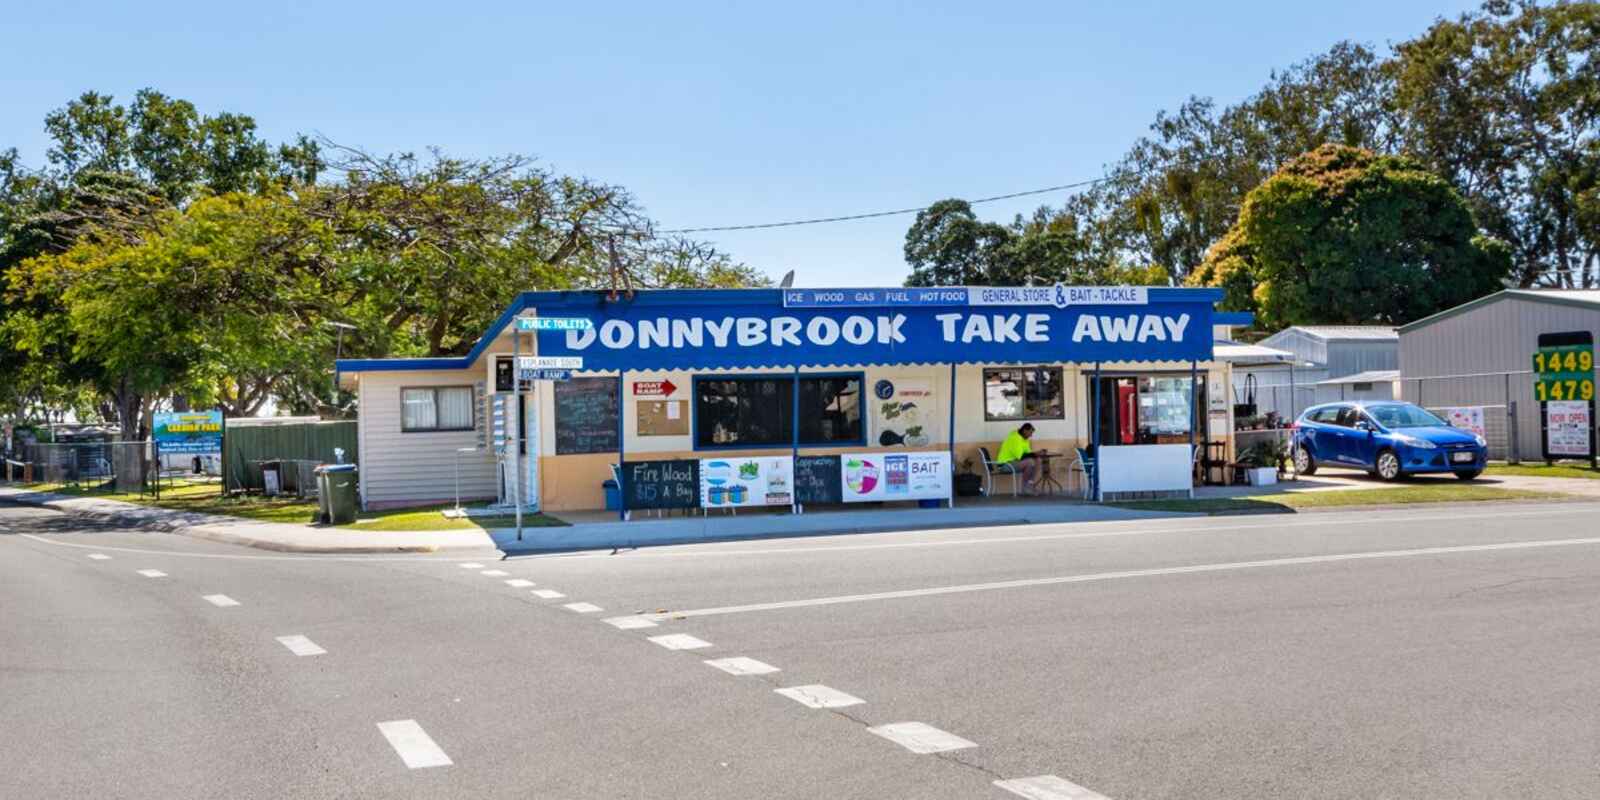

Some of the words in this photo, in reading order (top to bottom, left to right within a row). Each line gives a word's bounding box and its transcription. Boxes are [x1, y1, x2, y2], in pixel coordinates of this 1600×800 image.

[787, 293, 803, 303] ICE
[814, 293, 845, 302] WOOD
[855, 292, 875, 302] GAS
[885, 292, 909, 302] FUEL
[919, 291, 939, 301] HOT
[940, 291, 965, 301] FOOD
[982, 289, 1021, 302] GENERAL
[1024, 289, 1051, 302] STORE
[1055, 285, 1066, 305] &
[1070, 289, 1092, 301] BAIT
[1100, 288, 1137, 301] TACKLE
[522, 319, 553, 329] PUBLIC
[554, 319, 584, 329] TOILETS
[565, 313, 907, 350] DONNYBROOK
[936, 313, 1051, 343] TAKE
[1072, 312, 1190, 343] AWAY
[1535, 351, 1593, 372] 1449
[544, 370, 564, 378] RAMP
[1537, 380, 1594, 401] 1479
[633, 462, 659, 482] Fire
[662, 463, 692, 482] Wood
[911, 462, 940, 474] BAIT
